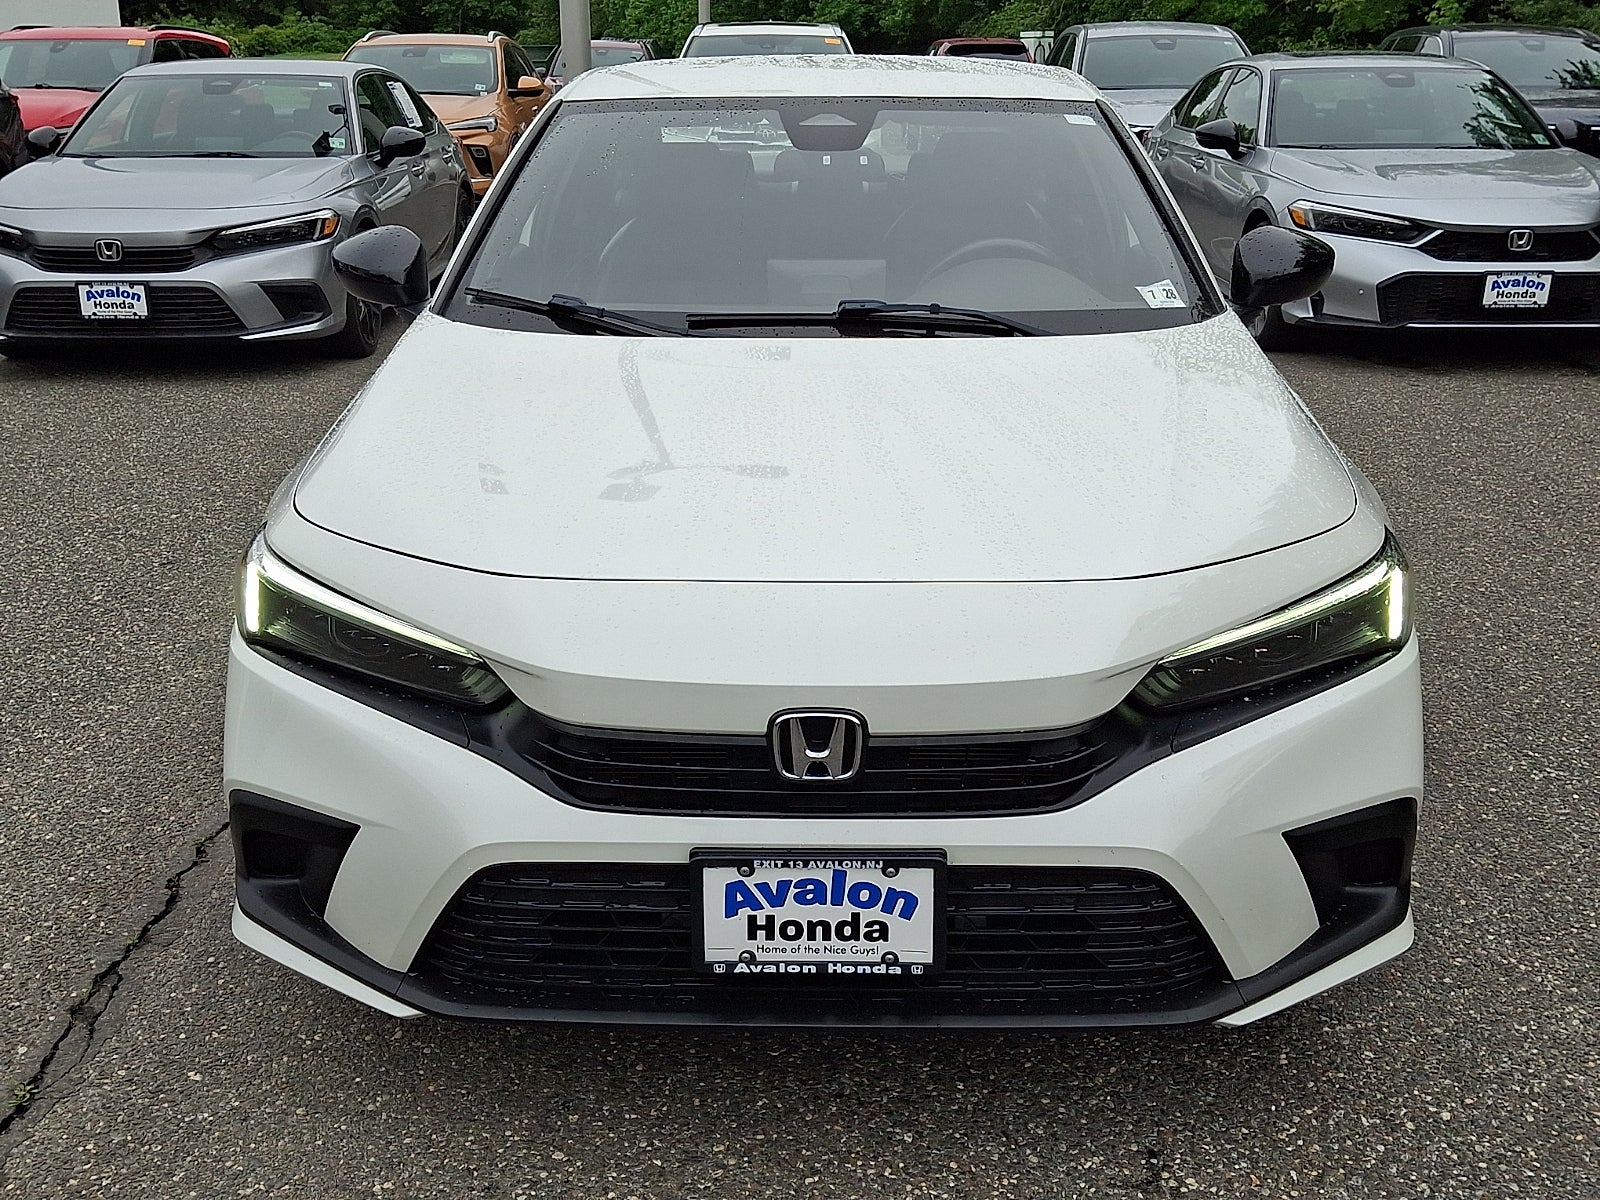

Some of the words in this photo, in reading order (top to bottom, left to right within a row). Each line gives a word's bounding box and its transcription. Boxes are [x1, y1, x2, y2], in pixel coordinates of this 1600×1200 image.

[1491, 276, 1546, 291] Avalon
[85, 286, 142, 302] Avalon
[1147, 290, 1157, 300] 7
[1162, 288, 1177, 300] 28
[1496, 289, 1536, 299] Honda
[93, 300, 135, 310] Honda
[753, 860, 784, 869] EXIT
[788, 860, 804, 869] 13
[807, 860, 884, 870] AVALON,NJ
[724, 869, 919, 921] Avalon
[747, 912, 889, 943] Honda
[756, 944, 787, 954] Home
[790, 944, 801, 954] of
[804, 945, 820, 954] the
[823, 945, 847, 955] Nice
[850, 945, 879, 957] Guys!
[734, 962, 817, 973] Avalon
[828, 962, 902, 974] Honda
